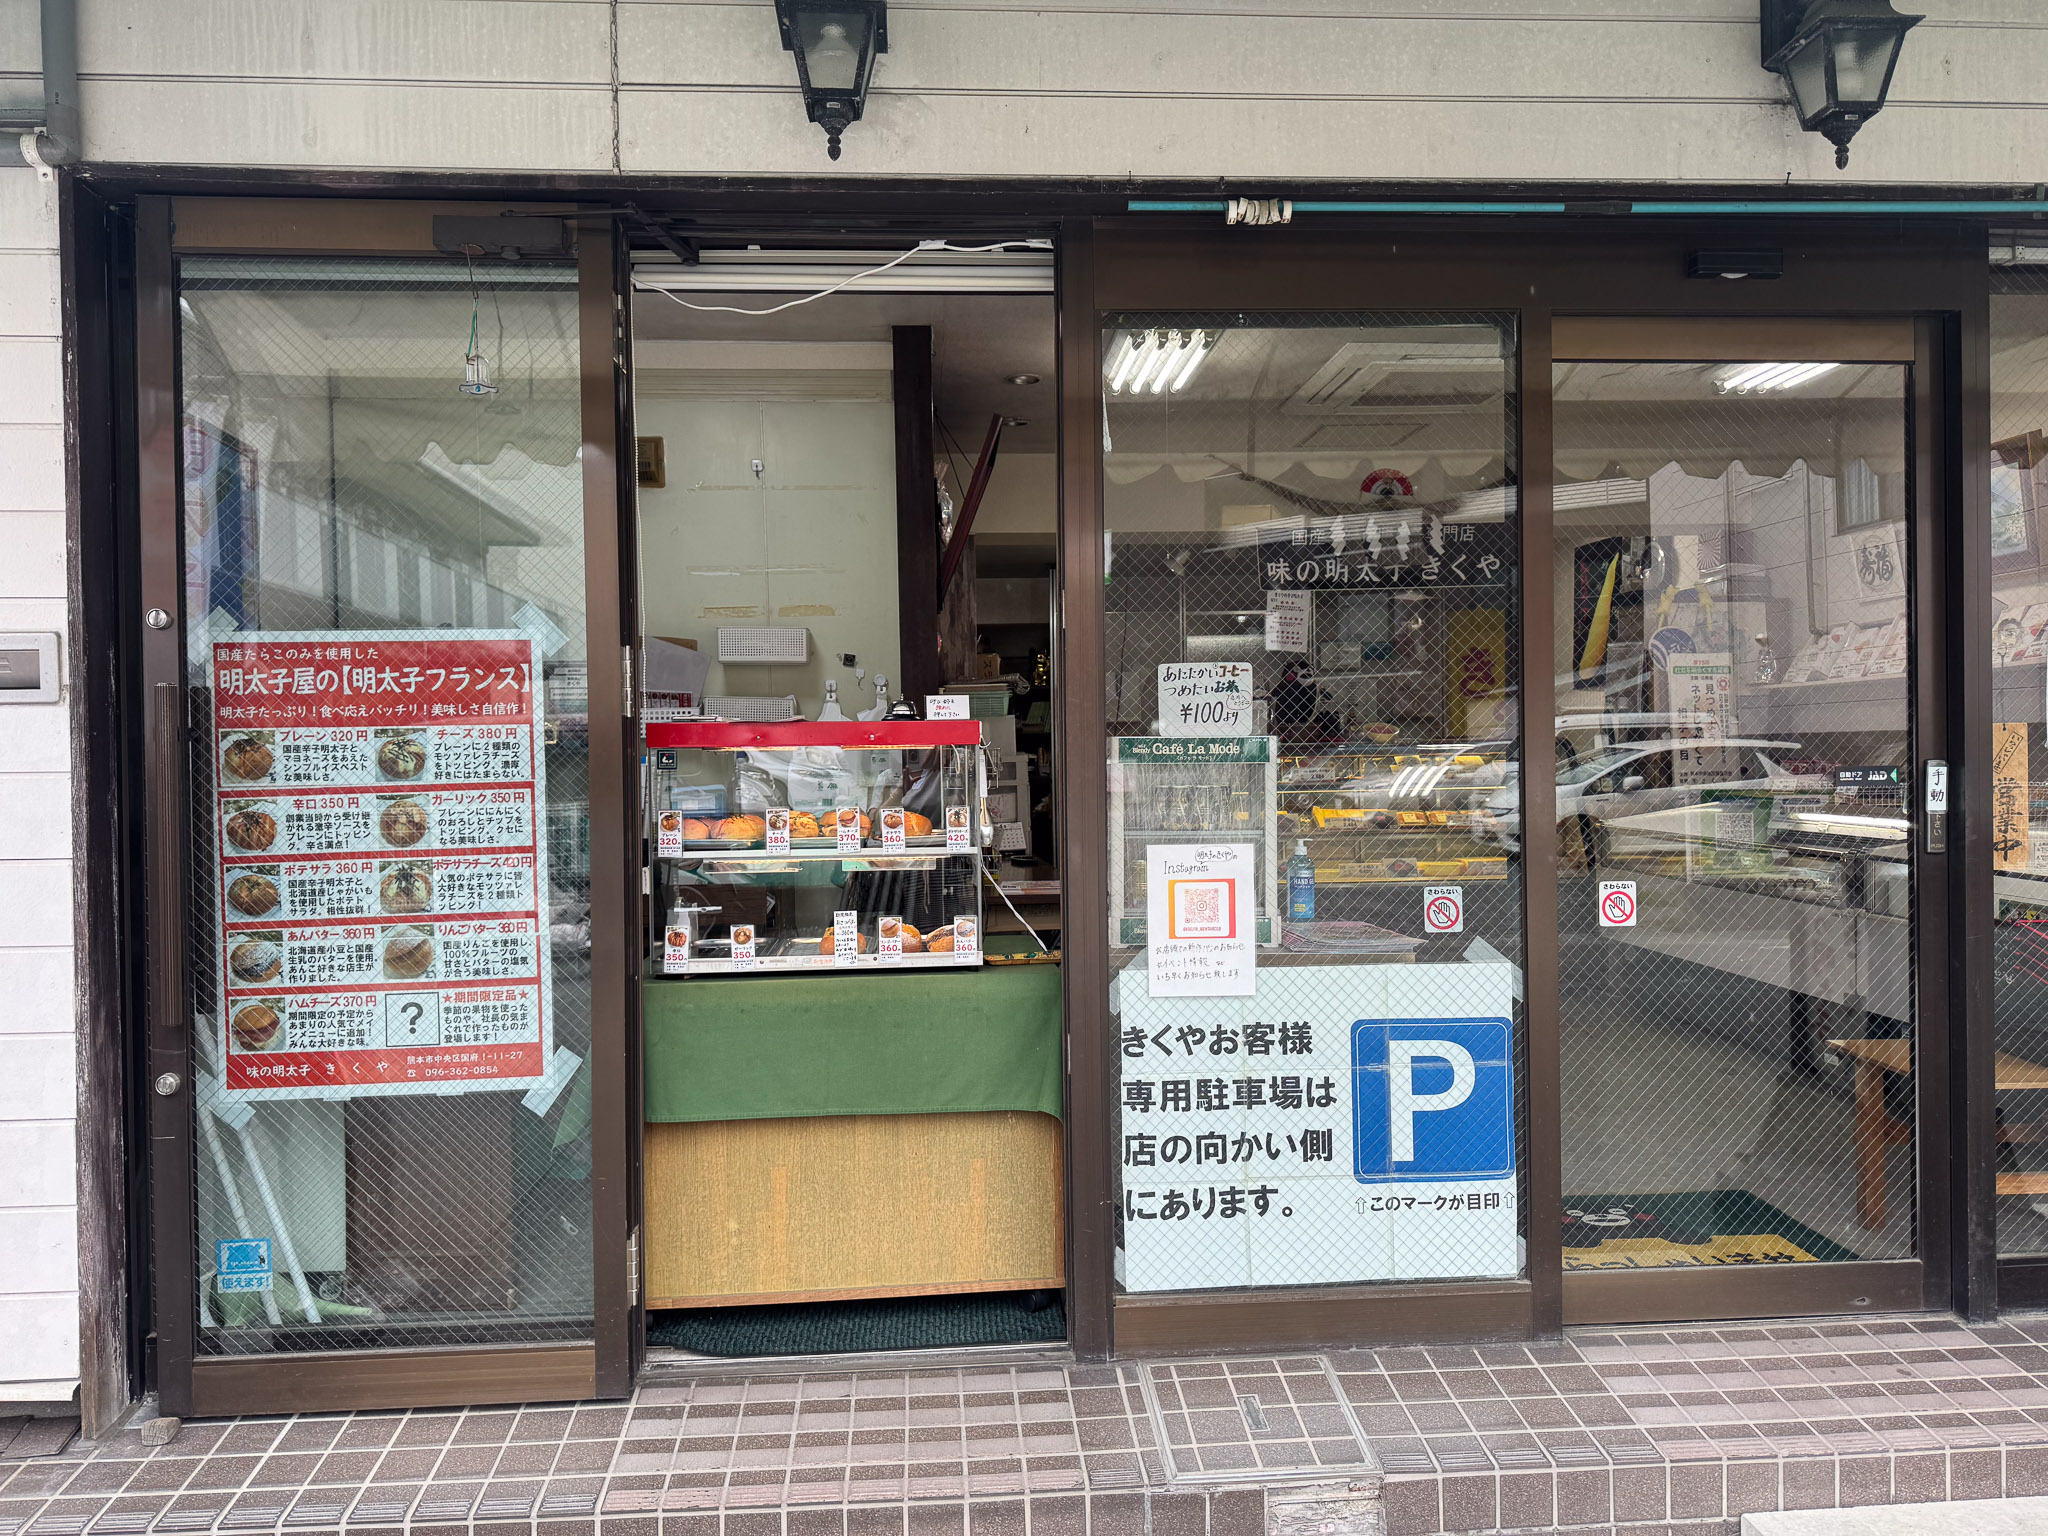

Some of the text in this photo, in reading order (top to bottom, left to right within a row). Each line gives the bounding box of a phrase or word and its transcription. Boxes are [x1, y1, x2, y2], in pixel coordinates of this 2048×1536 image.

[217, 647, 379, 662] 国産たらこのみを使用した
[219, 663, 530, 696] 明太子屋の【明太子フランス】
[1152, 743, 1184, 755] Café
[1187, 743, 1205, 754] La
[1208, 743, 1241, 754] Mode
[283, 753, 368, 763] マヨネーズをあえた
[434, 751, 520, 760] モッツァレラチーズ
[283, 762, 368, 772] シンプルイズベスト
[284, 773, 334, 782] な美味しさ。
[434, 770, 525, 780] 好きにはたまらない。
[1867, 770, 1888, 781] JAD
[1930, 767, 1945, 803] 手動
[438, 807, 521, 817] プレーンににんにく
[286, 820, 371, 832] がれる激辛ソースを
[439, 835, 500, 846] なる美味しさ。
[1163, 860, 1210, 875] Instagram
[288, 877, 363, 888] 国産辛子明太子と
[289, 886, 373, 898] 北海道産じゃがいも
[289, 896, 363, 907] を使用したポテト
[288, 944, 374, 955] 北海道産小豆と国産
[444, 956, 529, 968] 甘さとバターの塩気
[288, 963, 374, 974] あんこ好きな店主が
[288, 973, 341, 984] 作りました。
[288, 1009, 374, 1021] 期間限定の予定から
[443, 1003, 528, 1015] 季節の果物を使った
[288, 1018, 374, 1030] あまりの人気でメイ
[444, 1022, 529, 1033] ぐれで作ったものが
[288, 1037, 370, 1049] みんな大好きな味。
[1121, 1021, 1314, 1058] きくやお客様
[246, 1064, 311, 1078] 味の明太子
[1122, 1075, 1338, 1113] 専用駐車場は
[1389, 1039, 1476, 1162] P
[1123, 1128, 1334, 1168] 店の向かい側
[1126, 1184, 1293, 1222] にあります。
[1370, 1191, 1501, 1212] このマークが目印
